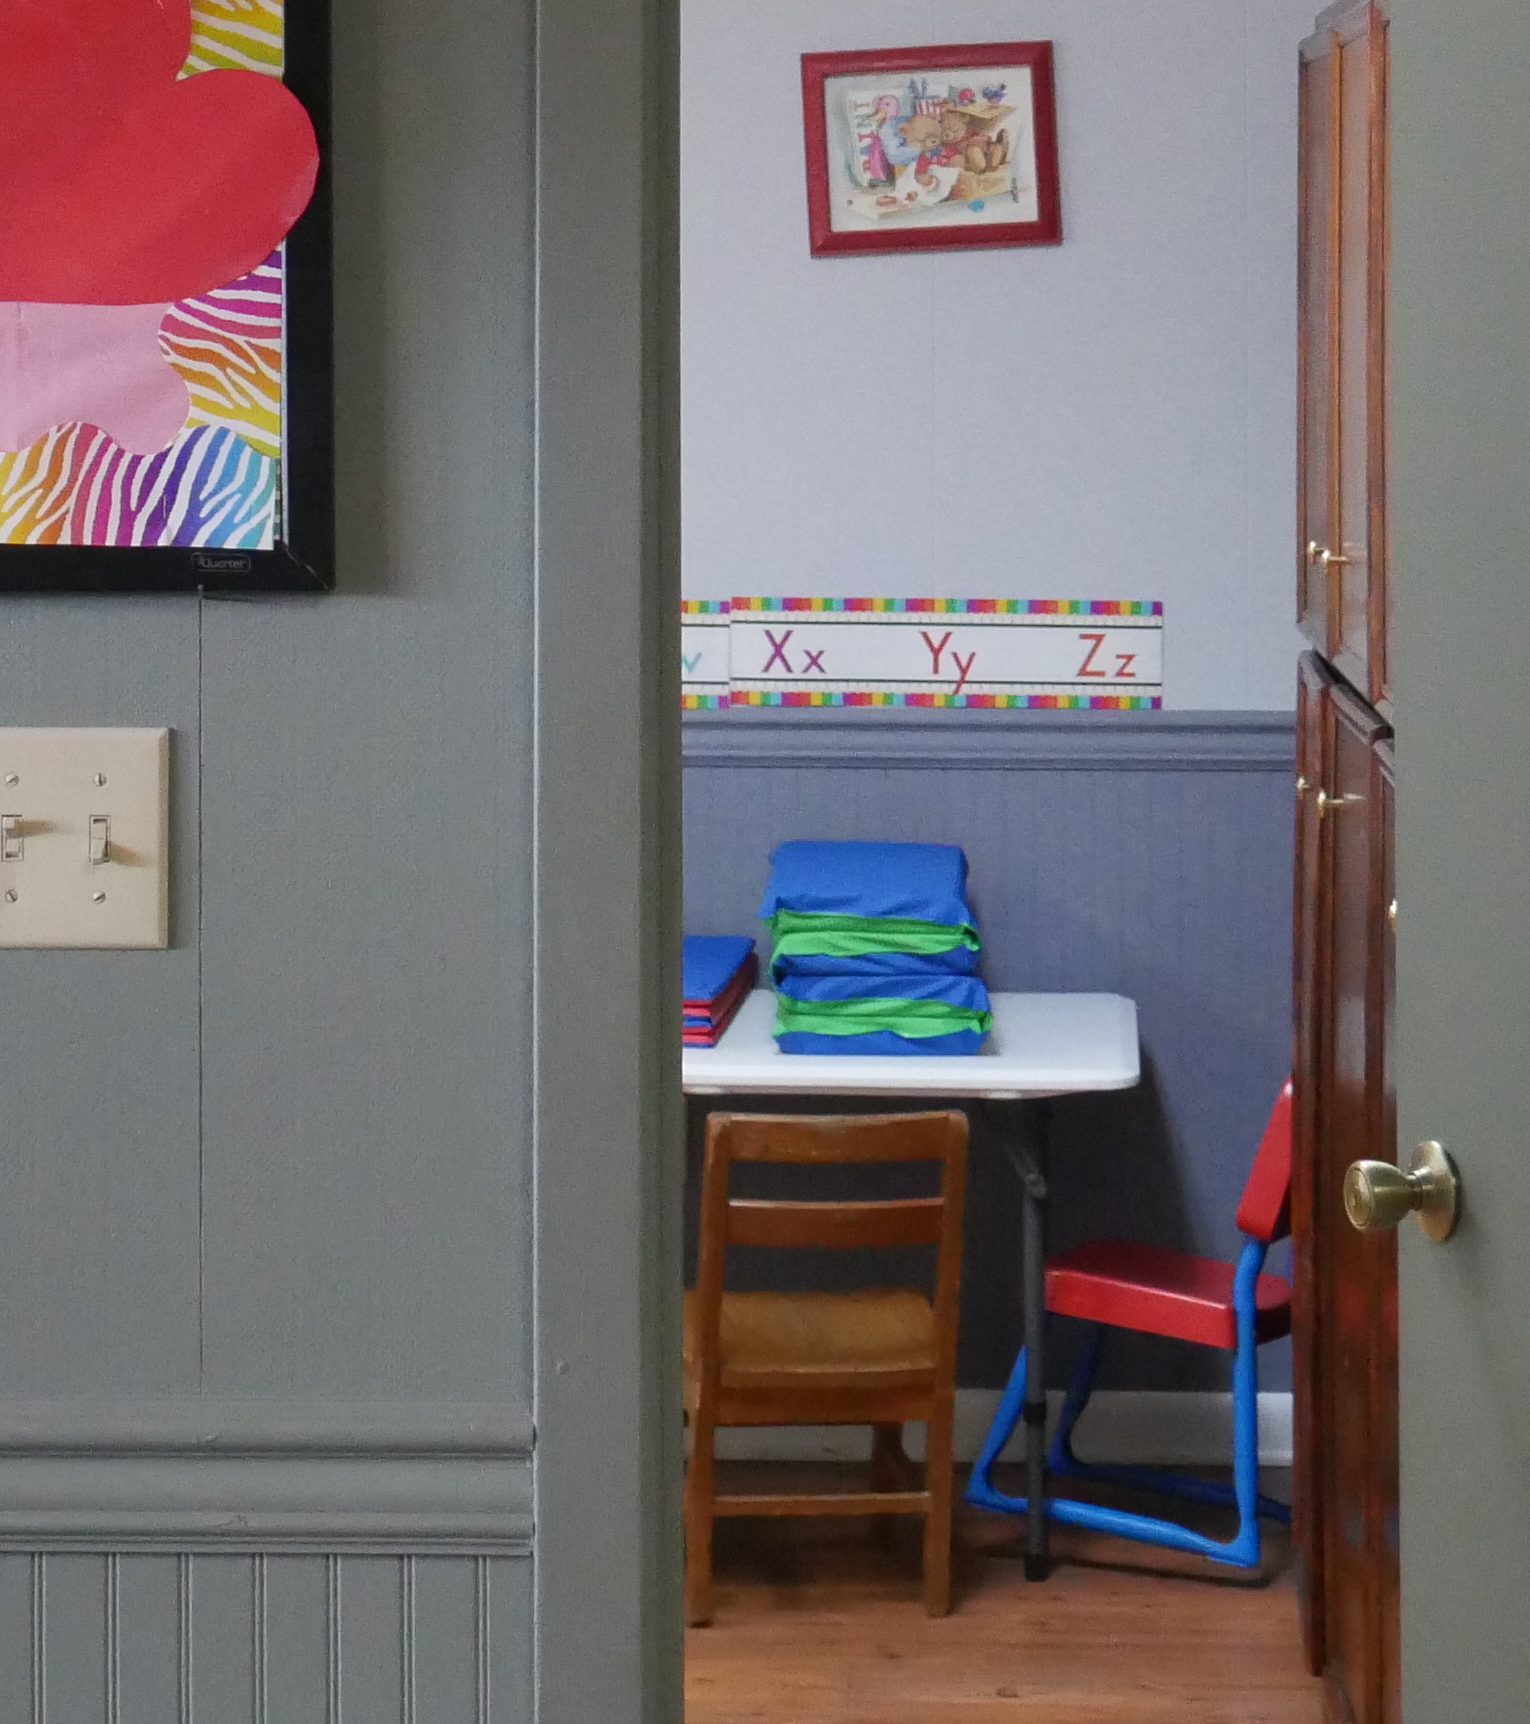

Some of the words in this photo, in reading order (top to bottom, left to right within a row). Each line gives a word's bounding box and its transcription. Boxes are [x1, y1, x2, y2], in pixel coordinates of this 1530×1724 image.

[761, 628, 827, 675] Xx
[919, 630, 977, 696] Yy
[1075, 632, 1138, 679] Zz
